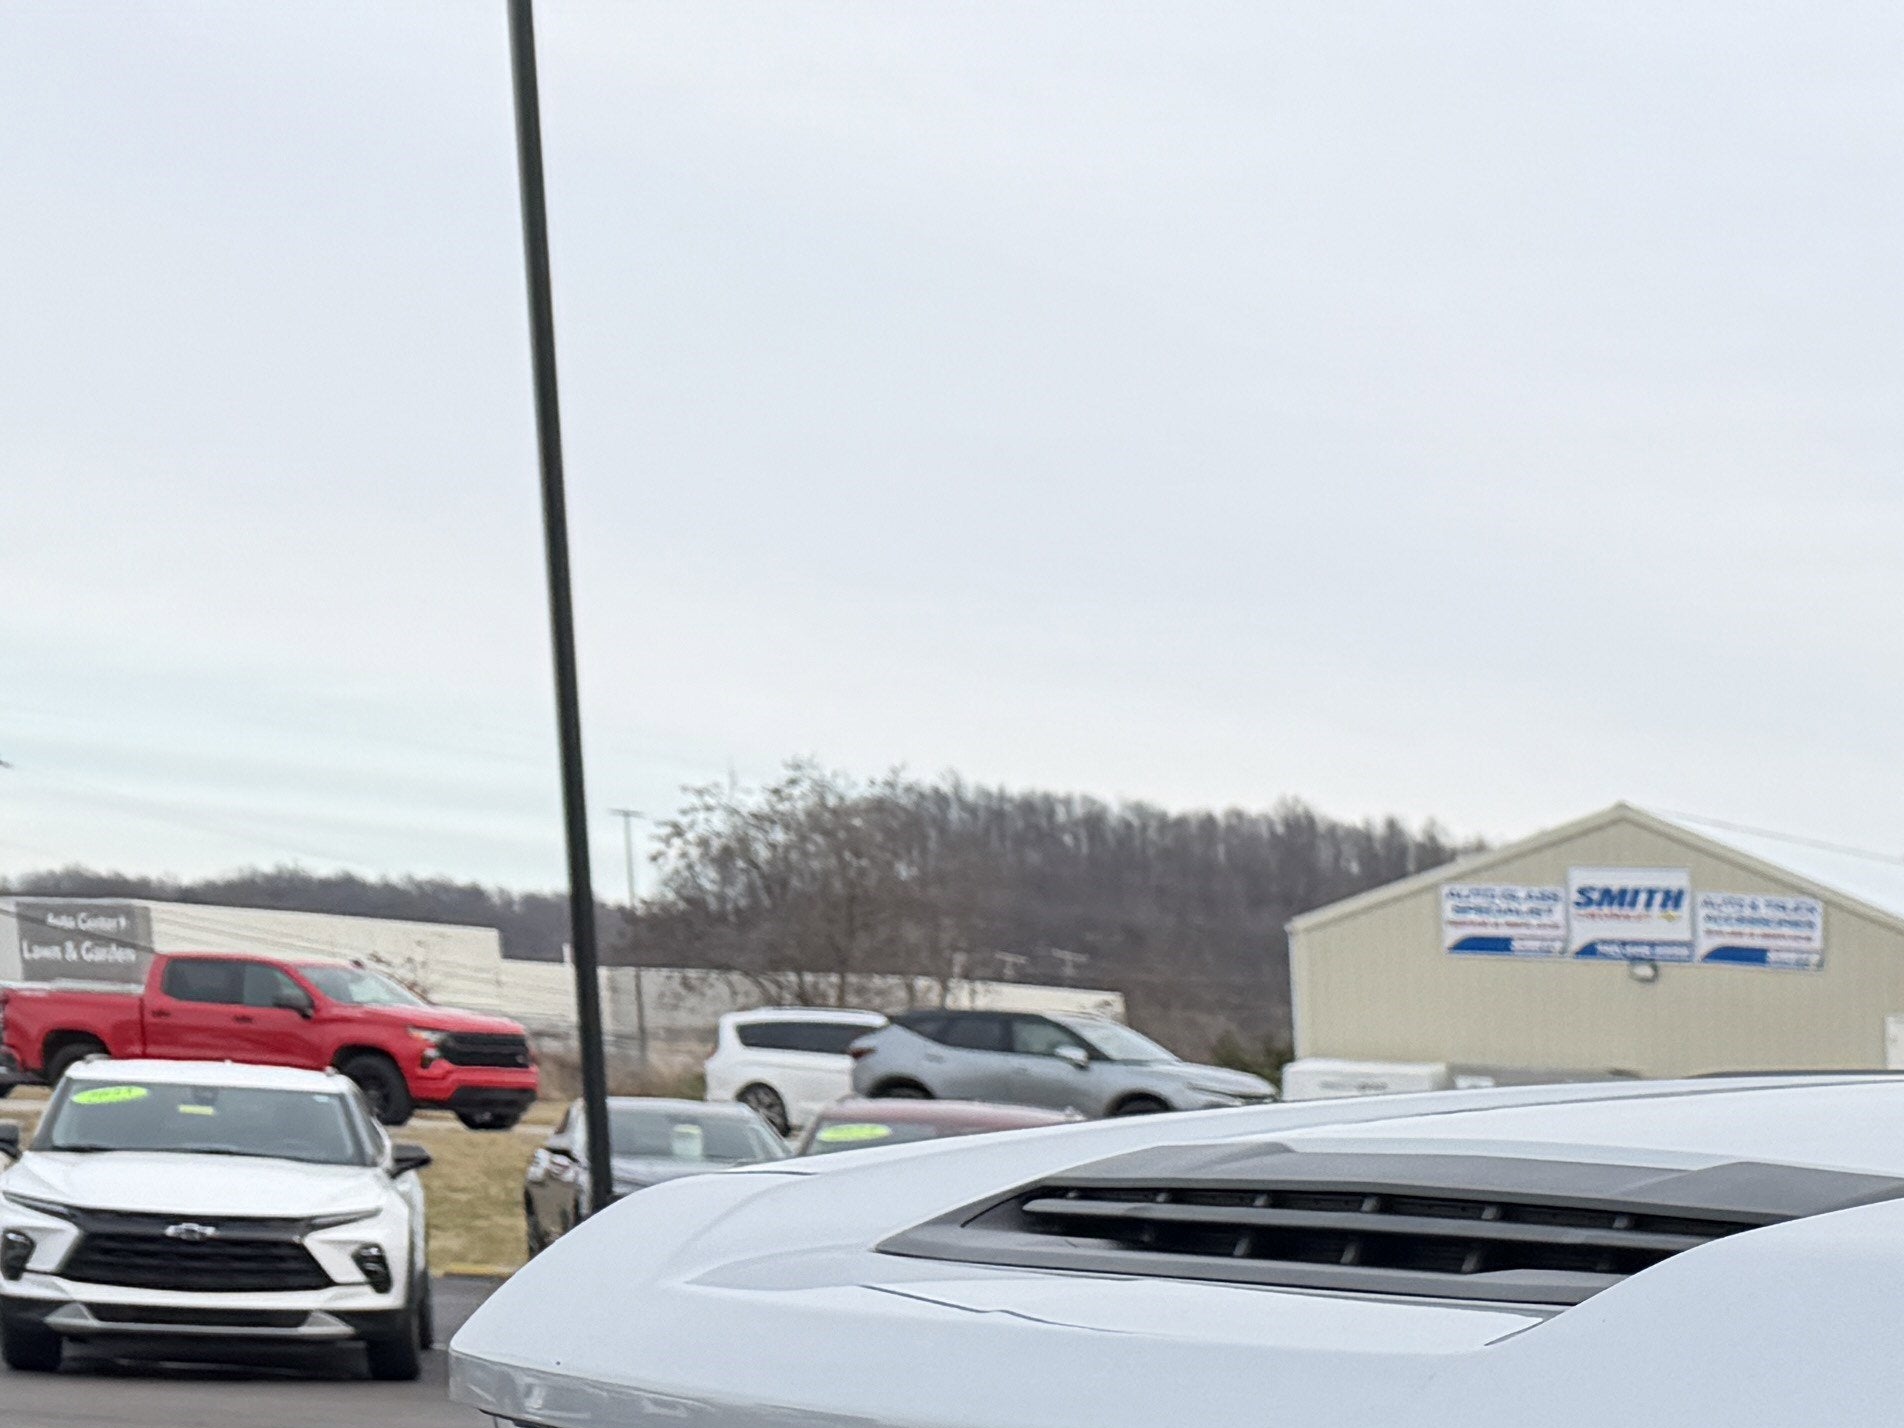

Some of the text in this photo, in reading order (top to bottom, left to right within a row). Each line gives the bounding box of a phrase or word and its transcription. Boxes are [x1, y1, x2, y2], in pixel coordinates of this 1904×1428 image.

[1573, 885, 1685, 911] SMITH
[22, 940, 137, 963] Lawn & Garden
